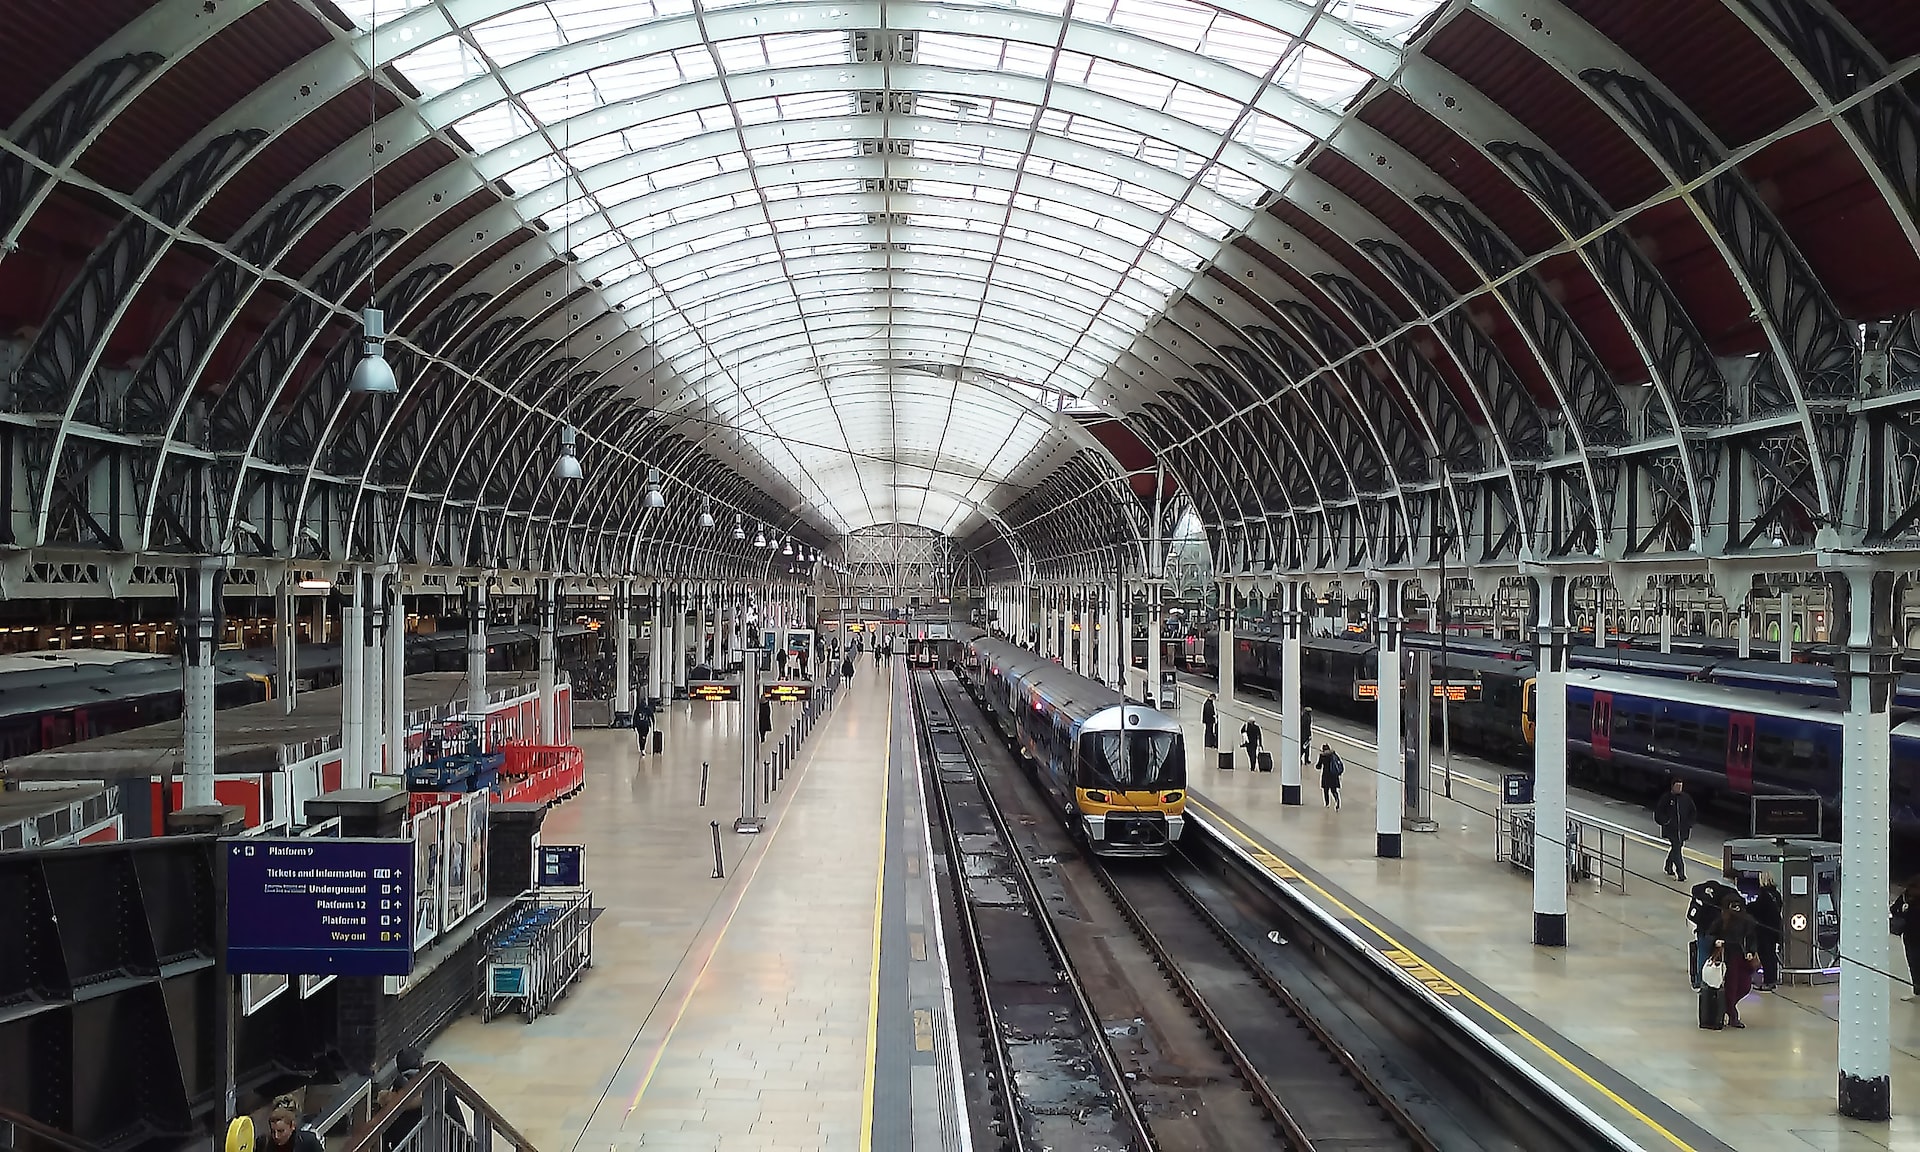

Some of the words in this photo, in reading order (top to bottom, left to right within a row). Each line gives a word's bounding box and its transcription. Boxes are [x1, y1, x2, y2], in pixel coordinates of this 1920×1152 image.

[269, 847, 306, 856] Platform
[308, 847, 314, 856] 9
[267, 868, 296, 878] Tickets
[298, 869, 314, 878] and
[309, 885, 367, 895] Underground
[317, 900, 354, 910] Platform
[357, 900, 367, 909] 12
[322, 916, 359, 926] Platform
[331, 932, 349, 942] Way
[351, 933, 366, 941] out
